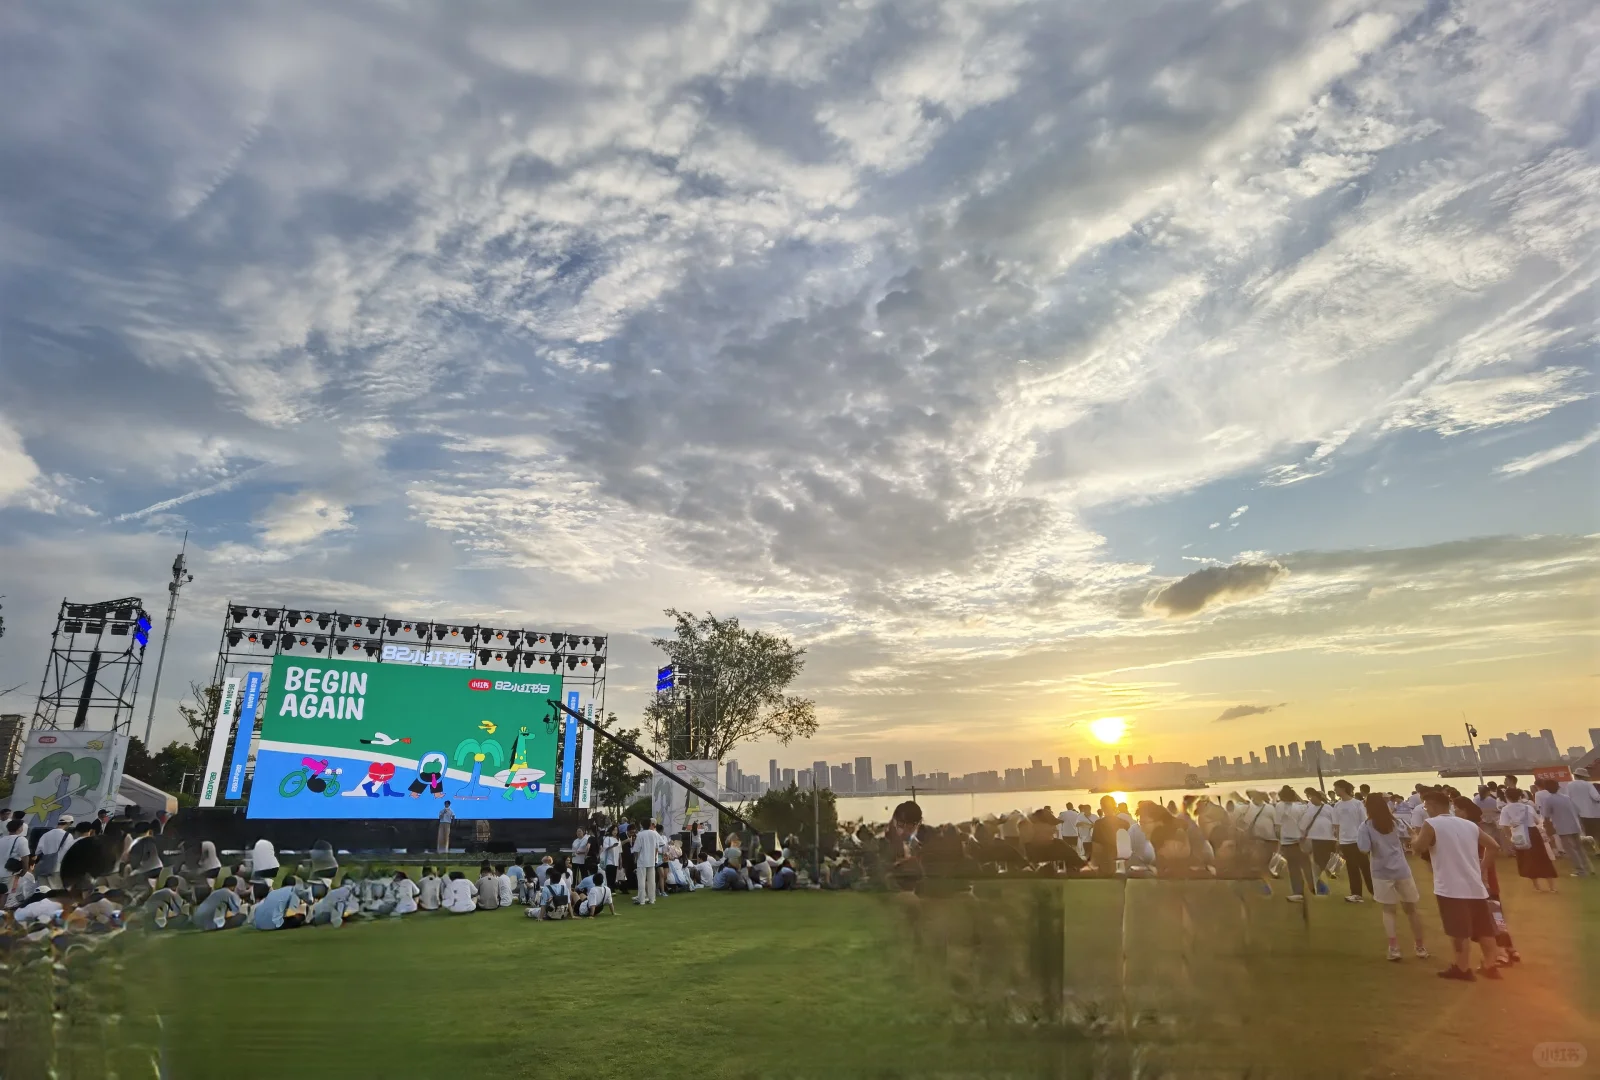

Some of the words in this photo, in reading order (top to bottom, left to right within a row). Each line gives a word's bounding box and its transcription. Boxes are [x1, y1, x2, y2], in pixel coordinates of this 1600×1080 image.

[284, 666, 368, 695] BEGIN
[471, 681, 490, 689] 小红书
[495, 681, 550, 693] 82小红书日
[226, 684, 235, 698] BEGIN
[279, 693, 364, 720] AGAIN
